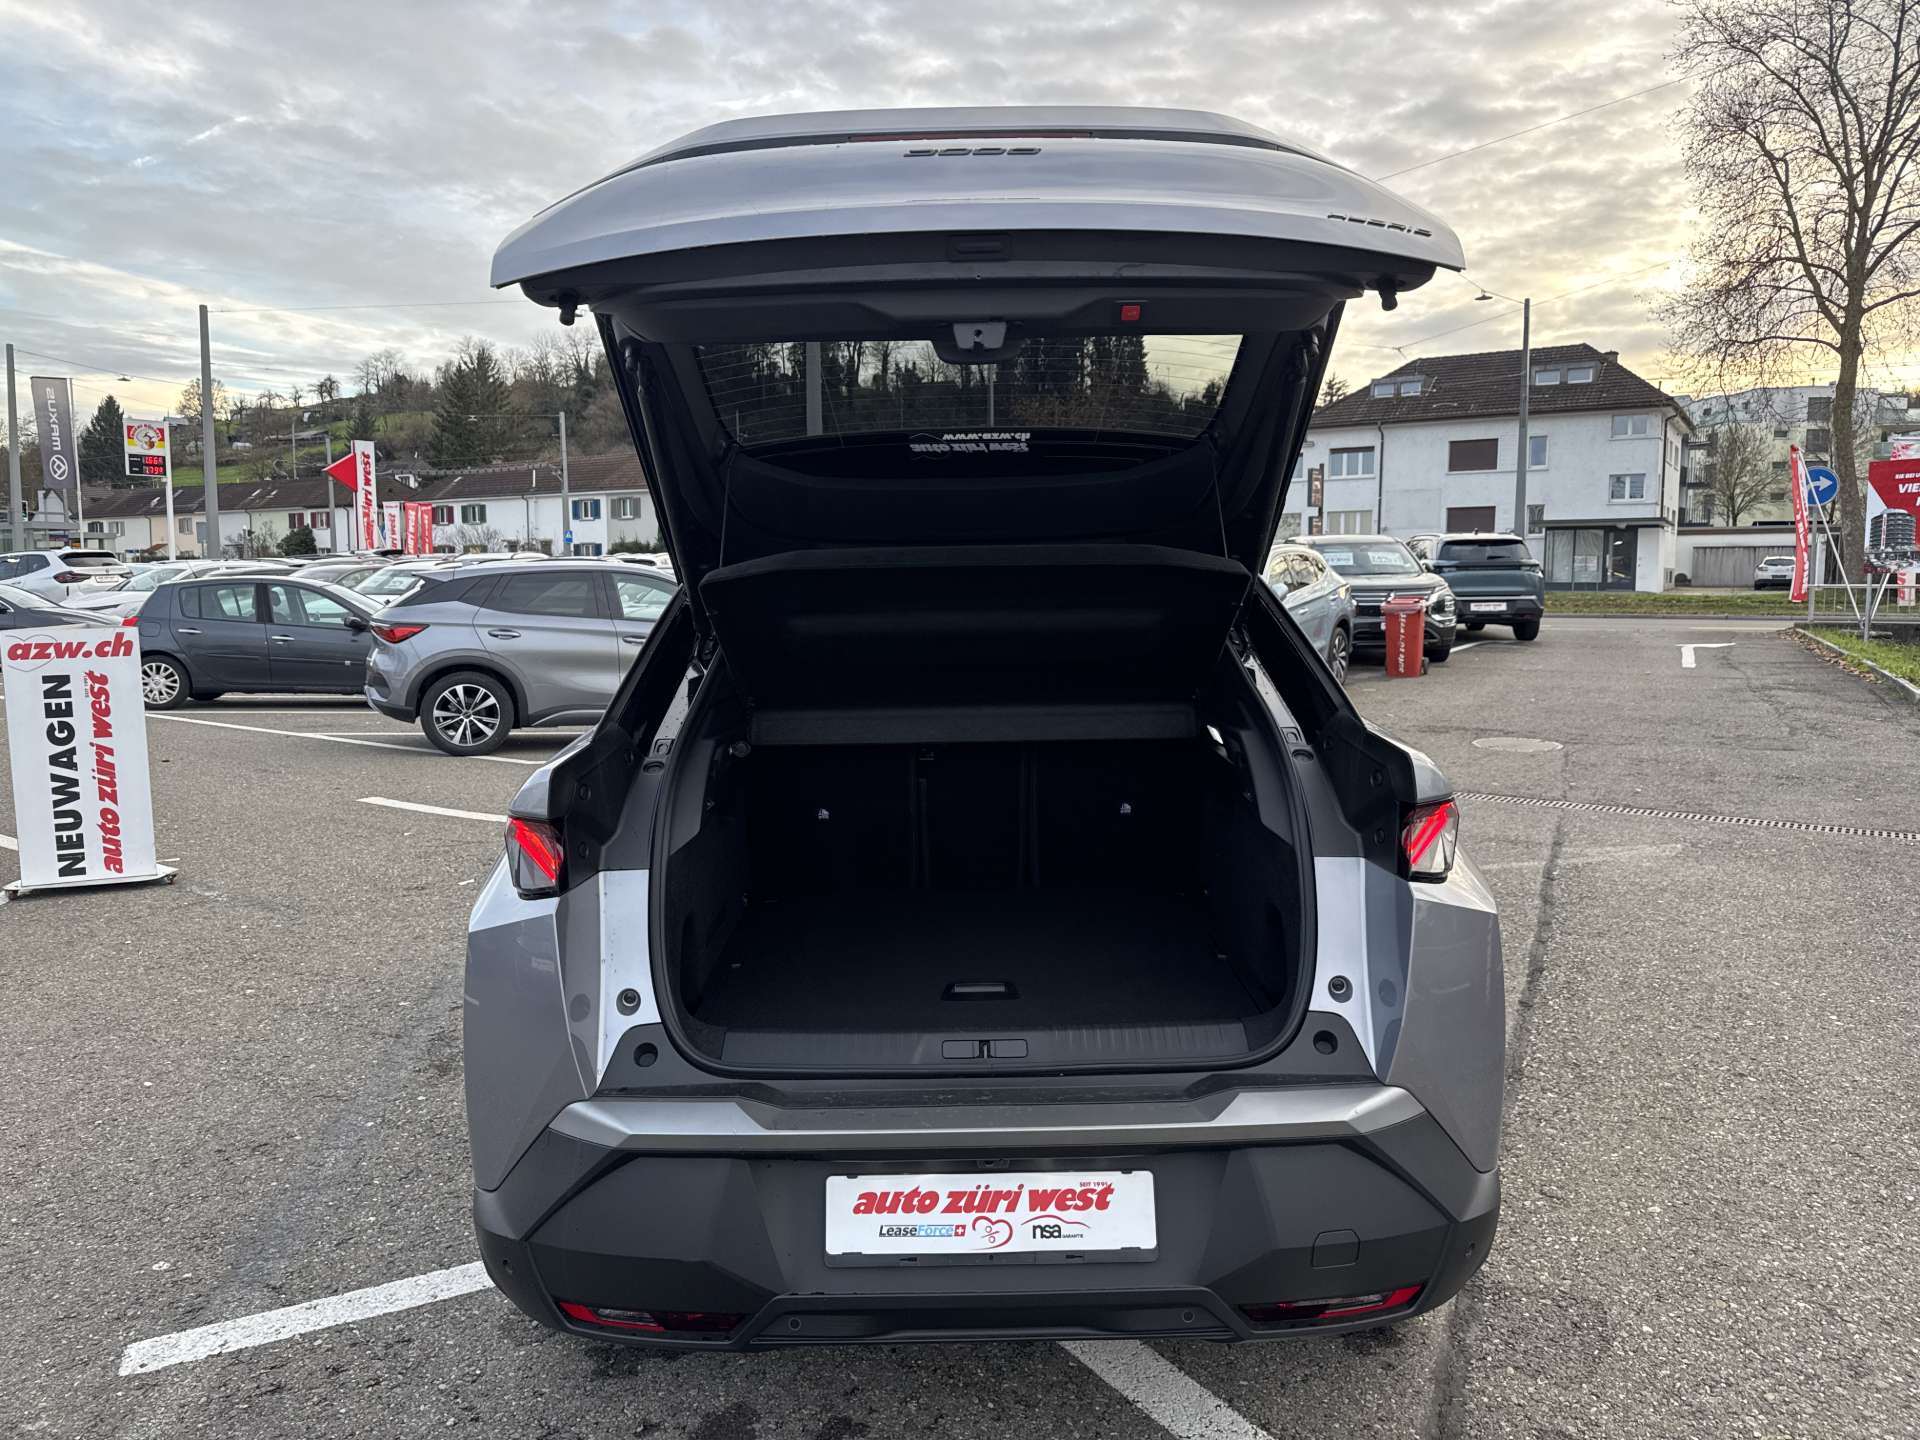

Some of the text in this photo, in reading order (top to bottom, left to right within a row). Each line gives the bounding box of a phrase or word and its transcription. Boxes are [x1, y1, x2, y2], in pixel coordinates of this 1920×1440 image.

[7, 632, 133, 660] azw.ch
[42, 674, 87, 877] NEUWAGEN
[85, 669, 123, 874] auto züri west
[853, 1181, 1114, 1215] auto züri west
[1032, 1223, 1062, 1240] nsa
